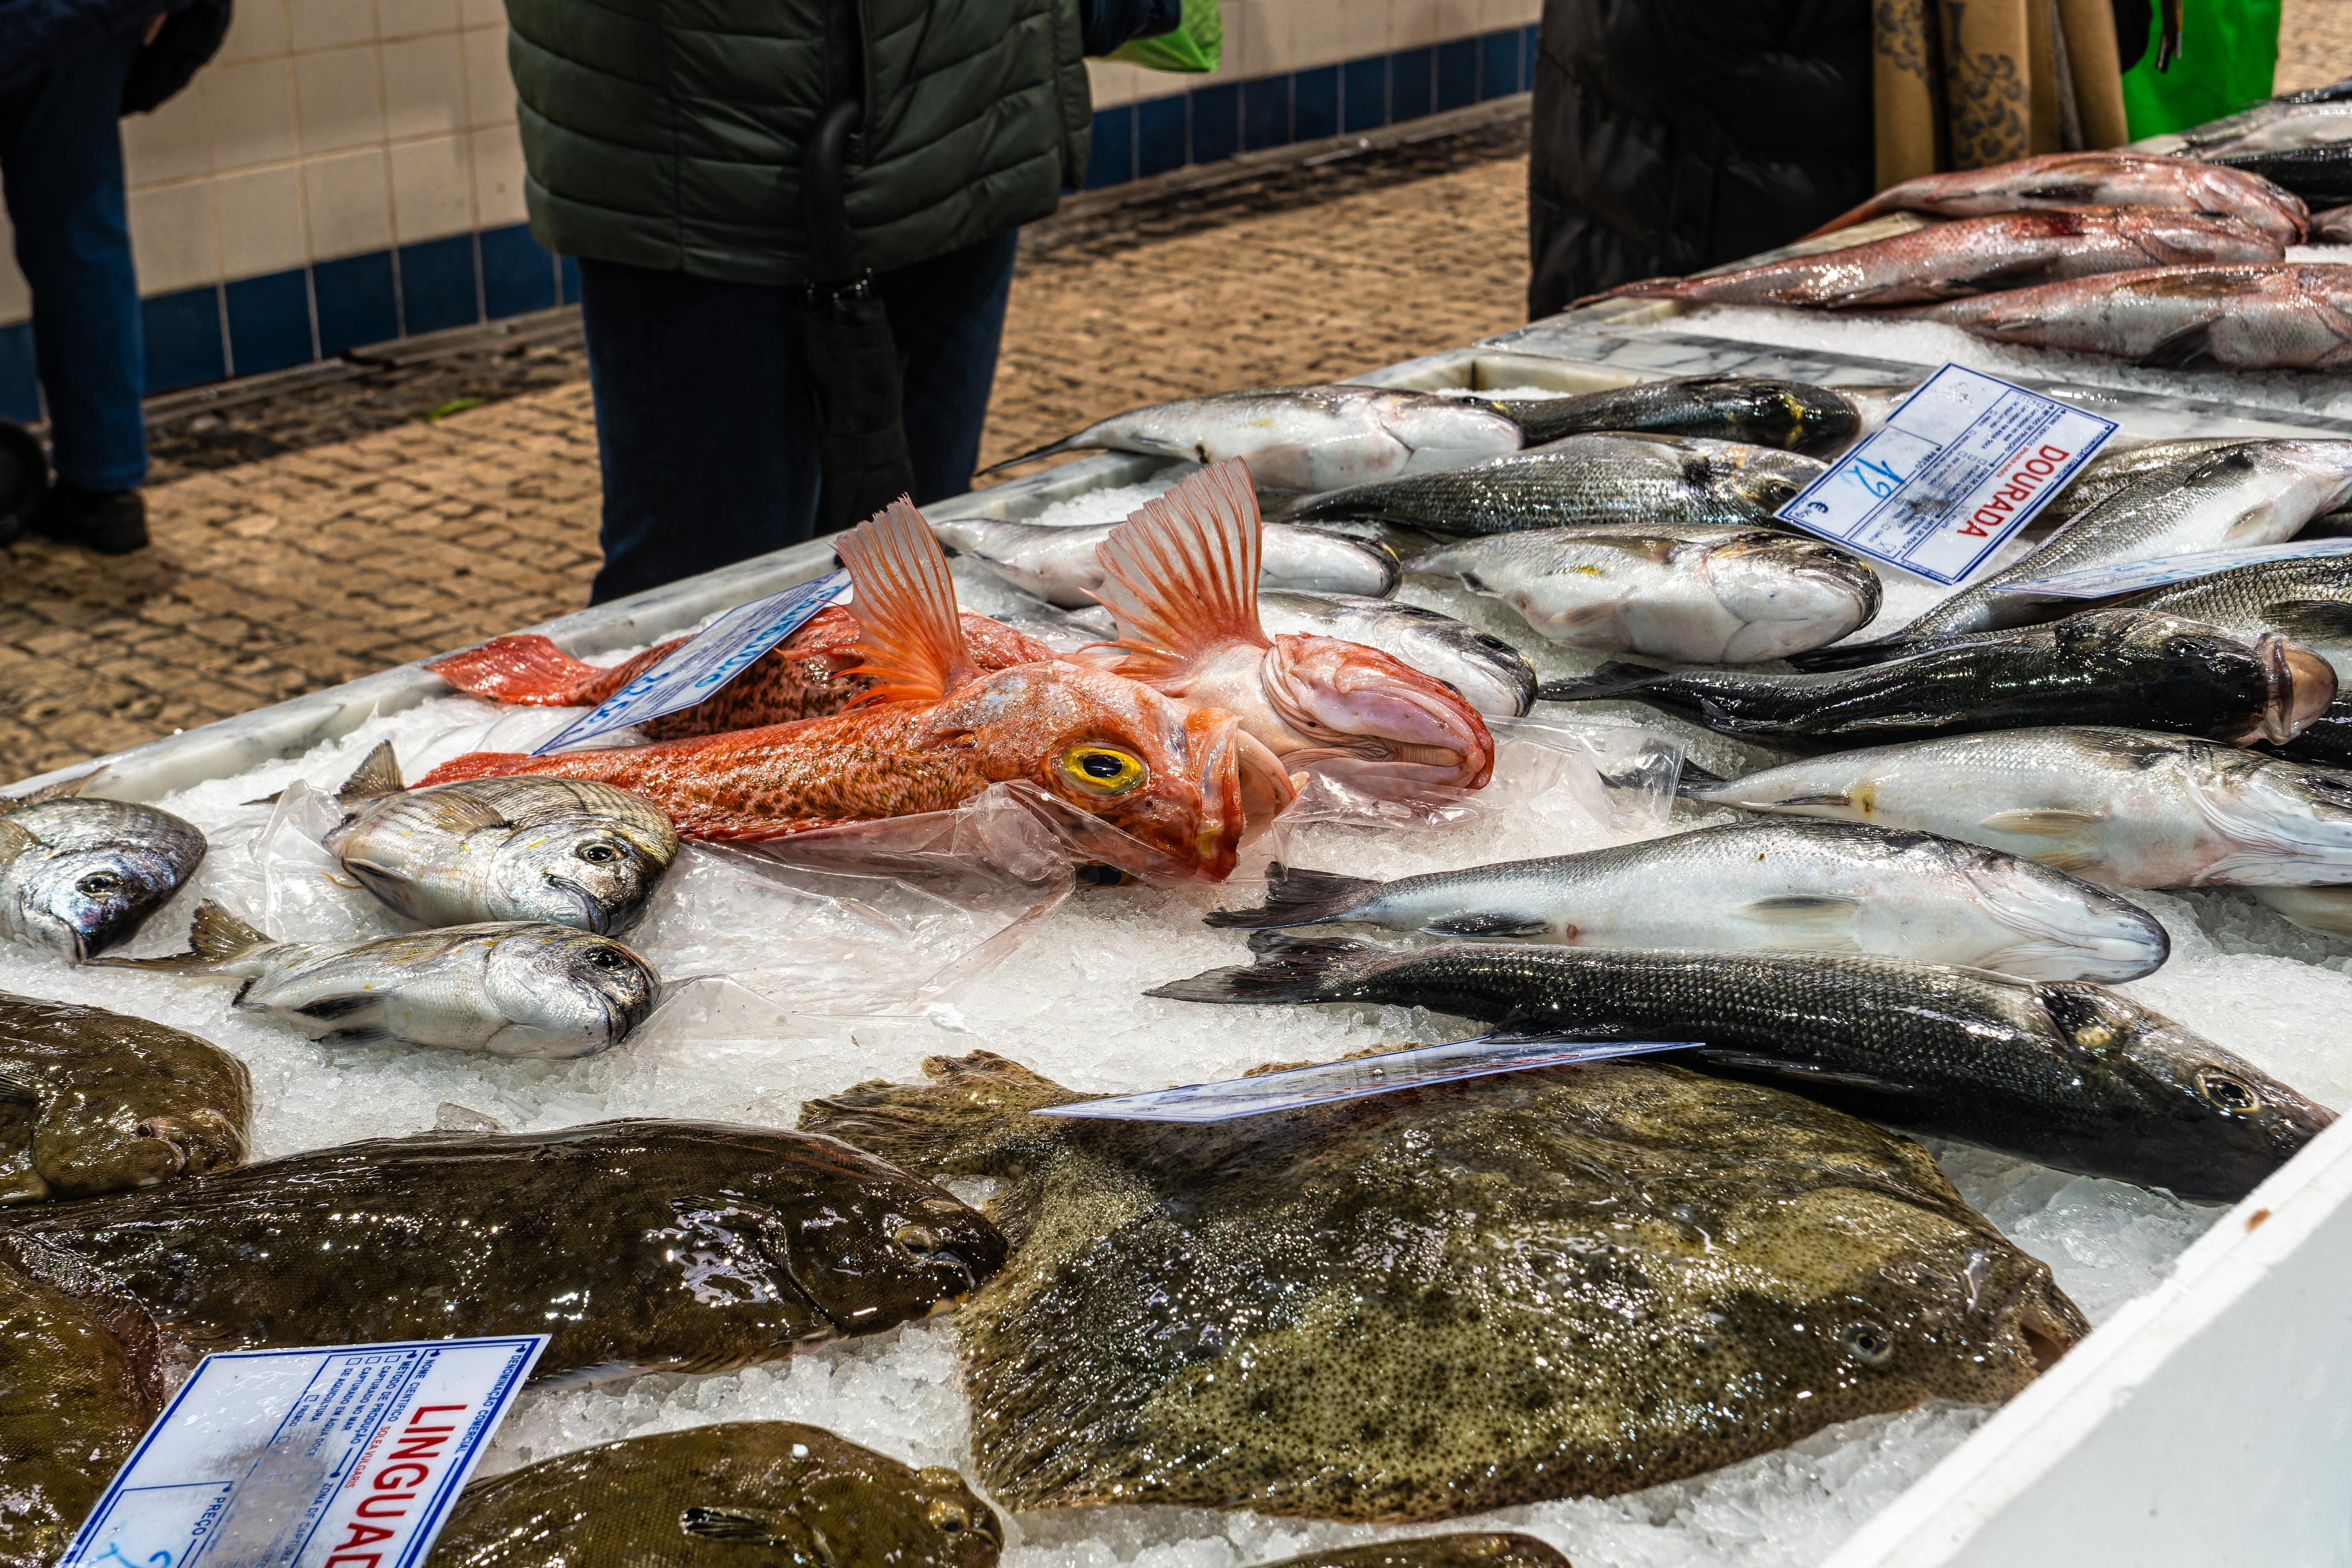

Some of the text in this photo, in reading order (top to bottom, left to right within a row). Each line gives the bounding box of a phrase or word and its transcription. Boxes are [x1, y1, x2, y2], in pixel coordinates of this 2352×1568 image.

[1843, 457, 1905, 499] 12
[1958, 446, 2068, 536] DOURADA
[289, 1405, 309, 1426] FRESCO
[305, 1367, 371, 1457] CAPTURADO EM ÁGUA DOCE
[309, 1368, 353, 1421] DE AQUICULTURA
[341, 1366, 391, 1431] CAPTURADO NO MAR
[344, 1359, 435, 1488] NOME CIENTIFICO SOLEA VULGARIS
[350, 1361, 412, 1444] MÉTODO DE PRODUÇÃO
[455, 1355, 522, 1454] DENOMINAÇÃO COMERCIAL
[191, 1497, 226, 1535] PREÇO
[312, 1483, 333, 1505] ZONA
